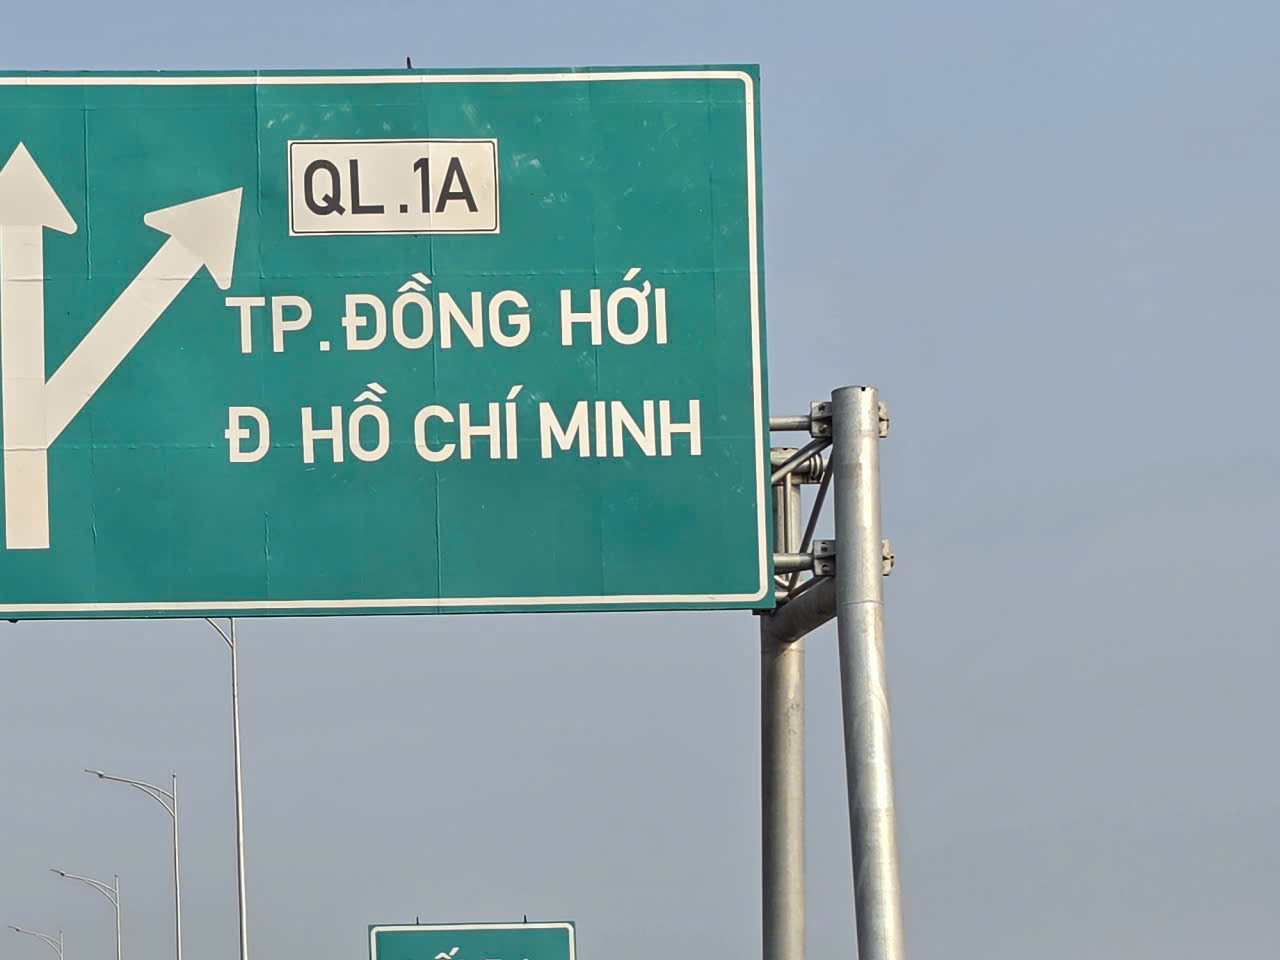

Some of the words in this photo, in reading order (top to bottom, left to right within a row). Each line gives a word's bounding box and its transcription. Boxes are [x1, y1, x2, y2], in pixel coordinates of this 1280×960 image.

[225, 272, 531, 354] TP.ĐỒNG
[560, 267, 668, 346] HỚI
[224, 406, 270, 463] Đ
[301, 382, 391, 464] HỒ
[413, 384, 524, 463] CHÍ
[539, 399, 702, 460] MINH
